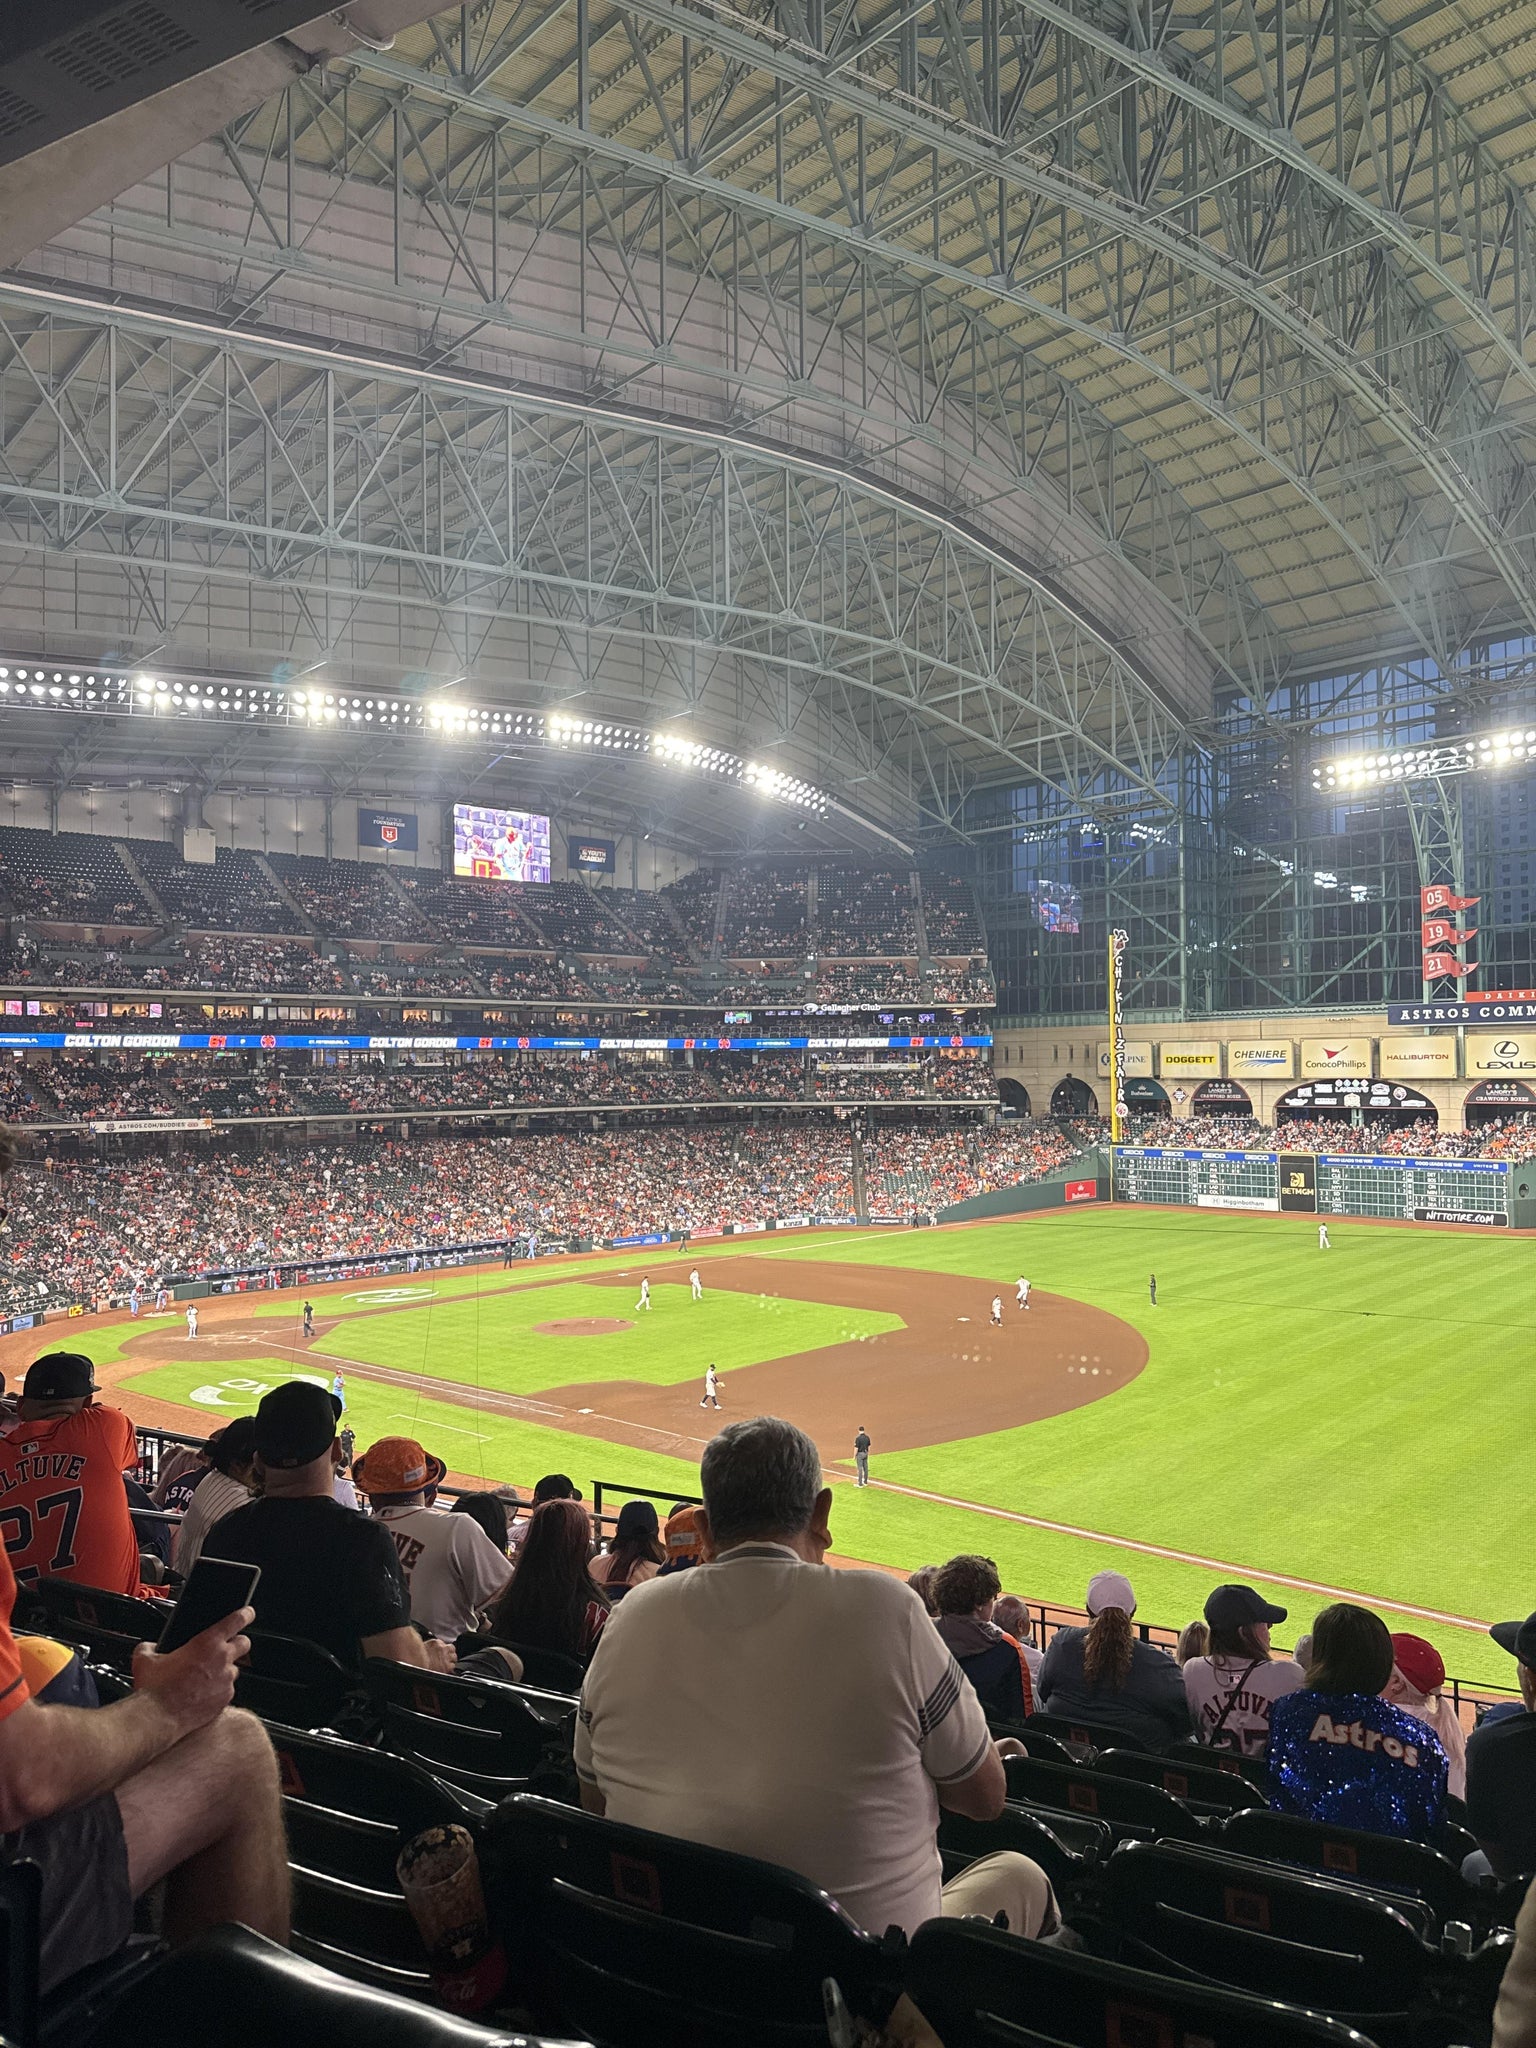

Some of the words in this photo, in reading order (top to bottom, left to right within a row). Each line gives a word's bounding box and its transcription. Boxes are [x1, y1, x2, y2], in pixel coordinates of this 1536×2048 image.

[1427, 890, 1443, 905] 05
[1428, 925, 1444, 939] 19
[1428, 958, 1442, 971] 21
[1114, 956, 1123, 1024] CHIKIN
[821, 1003, 861, 1012] Gallagher
[861, 1003, 881, 1011] Club
[1400, 1008, 1470, 1020] ASTROS
[64, 1035, 121, 1047] COLTON
[122, 1035, 180, 1047] GORDON
[369, 1037, 413, 1048] COLTON
[413, 1037, 458, 1048] GORDON
[599, 1039, 634, 1049] COLTON
[633, 1039, 668, 1049] GORDON
[807, 1037, 847, 1047] COLTON
[847, 1037, 890, 1047] GORDON
[1115, 1027, 1125, 1050] IZ
[1165, 1056, 1215, 1064] DOGGETT
[1234, 1050, 1287, 1059] CHENIERE
[1305, 1060, 1367, 1069] ConocoPhillips
[1476, 1061, 1536, 1070] LEXUS
[1115, 1053, 1125, 1102] FAIR
[118, 1122, 185, 1130] ASTROS.COM/BUDDIES
[1281, 1187, 1314, 1196] BETMGM
[1223, 1199, 1265, 1207] Higginbotham
[1426, 1210, 1495, 1225] NITTOTIRE.COM
[0, 1454, 87, 1498] LTUVE
[1308, 1714, 1418, 1768] Astros
